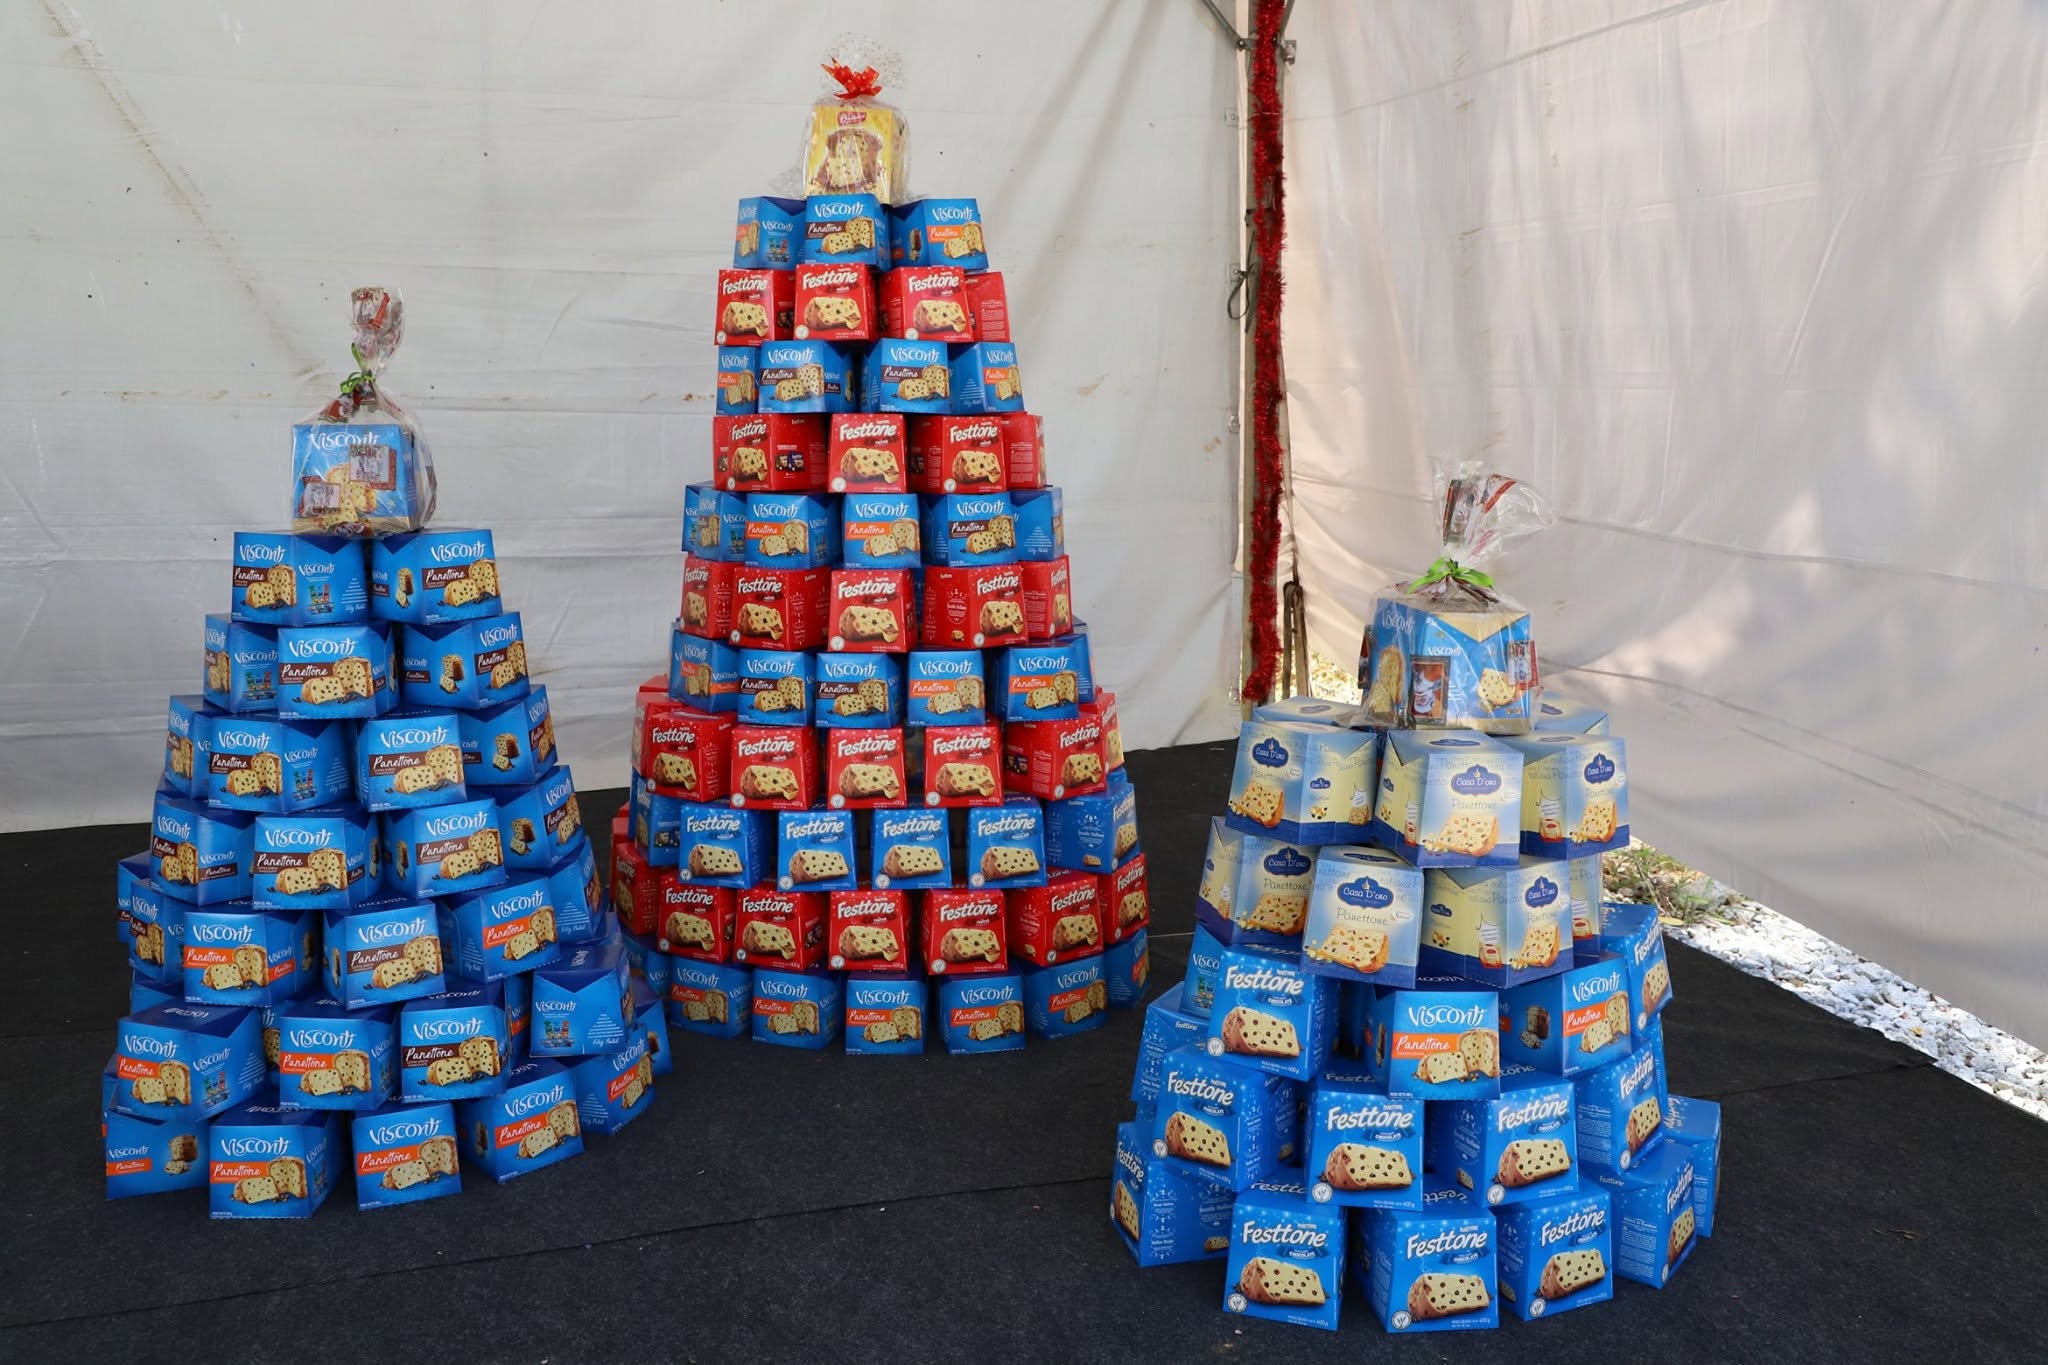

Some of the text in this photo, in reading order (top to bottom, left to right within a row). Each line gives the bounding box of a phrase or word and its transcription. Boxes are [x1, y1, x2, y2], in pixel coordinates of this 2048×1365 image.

[722, 277, 768, 294] Festtone
[802, 271, 858, 290] Festtone
[908, 275, 960, 292] Festtone
[732, 424, 767, 439] Festtone
[839, 422, 897, 440] Festtone
[951, 425, 998, 441] Festtone
[738, 577, 783, 593] Festtone
[838, 580, 896, 597] Festtone
[977, 574, 1019, 592] Festtone
[281, 664, 328, 677] Panettone
[652, 727, 695, 744] Festtone
[1059, 727, 1100, 748] Festtone
[738, 739, 795, 757] Festtone
[838, 739, 897, 757] Festtone
[932, 736, 992, 755] Festtone
[373, 755, 421, 769] Panettone
[1455, 777, 1475, 787] Casa
[687, 816, 740, 832] Festtone
[786, 820, 845, 839] Festtone
[883, 818, 942, 837] Festtone
[977, 817, 1036, 836] Festtone
[420, 842, 464, 858] Panettone
[256, 853, 304, 867] Panettone
[1268, 859, 1287, 867] Casa
[1117, 867, 1144, 891] Festtone
[665, 888, 714, 905] Festtone
[1051, 889, 1095, 912] Festtone
[1342, 886, 1389, 901] Casa D'oro
[742, 896, 794, 912] Festtone
[837, 898, 895, 918] Festtone
[940, 901, 999, 921] Festtone
[1336, 906, 1389, 927] Panettone
[351, 950, 400, 966] Panettone
[1225, 965, 1305, 995] Festtone
[1396, 1035, 1451, 1050] Panettone
[282, 1054, 328, 1069] Panettone
[405, 1046, 454, 1061] Panettone
[1167, 1071, 1235, 1105] Festtone
[1327, 1099, 1414, 1133] Festtone
[1497, 1098, 1569, 1133] Festtone
[499, 1120, 543, 1139] Panettone
[362, 1151, 413, 1167] Panettone
[1117, 1141, 1145, 1183] Festtone
[213, 1162, 261, 1177] Panettone
[1667, 1165, 1694, 1215] Festtone
[1242, 1220, 1328, 1247] Festtone
[1540, 1209, 1605, 1247] Festtone
[1406, 1231, 1488, 1259] Festtone
